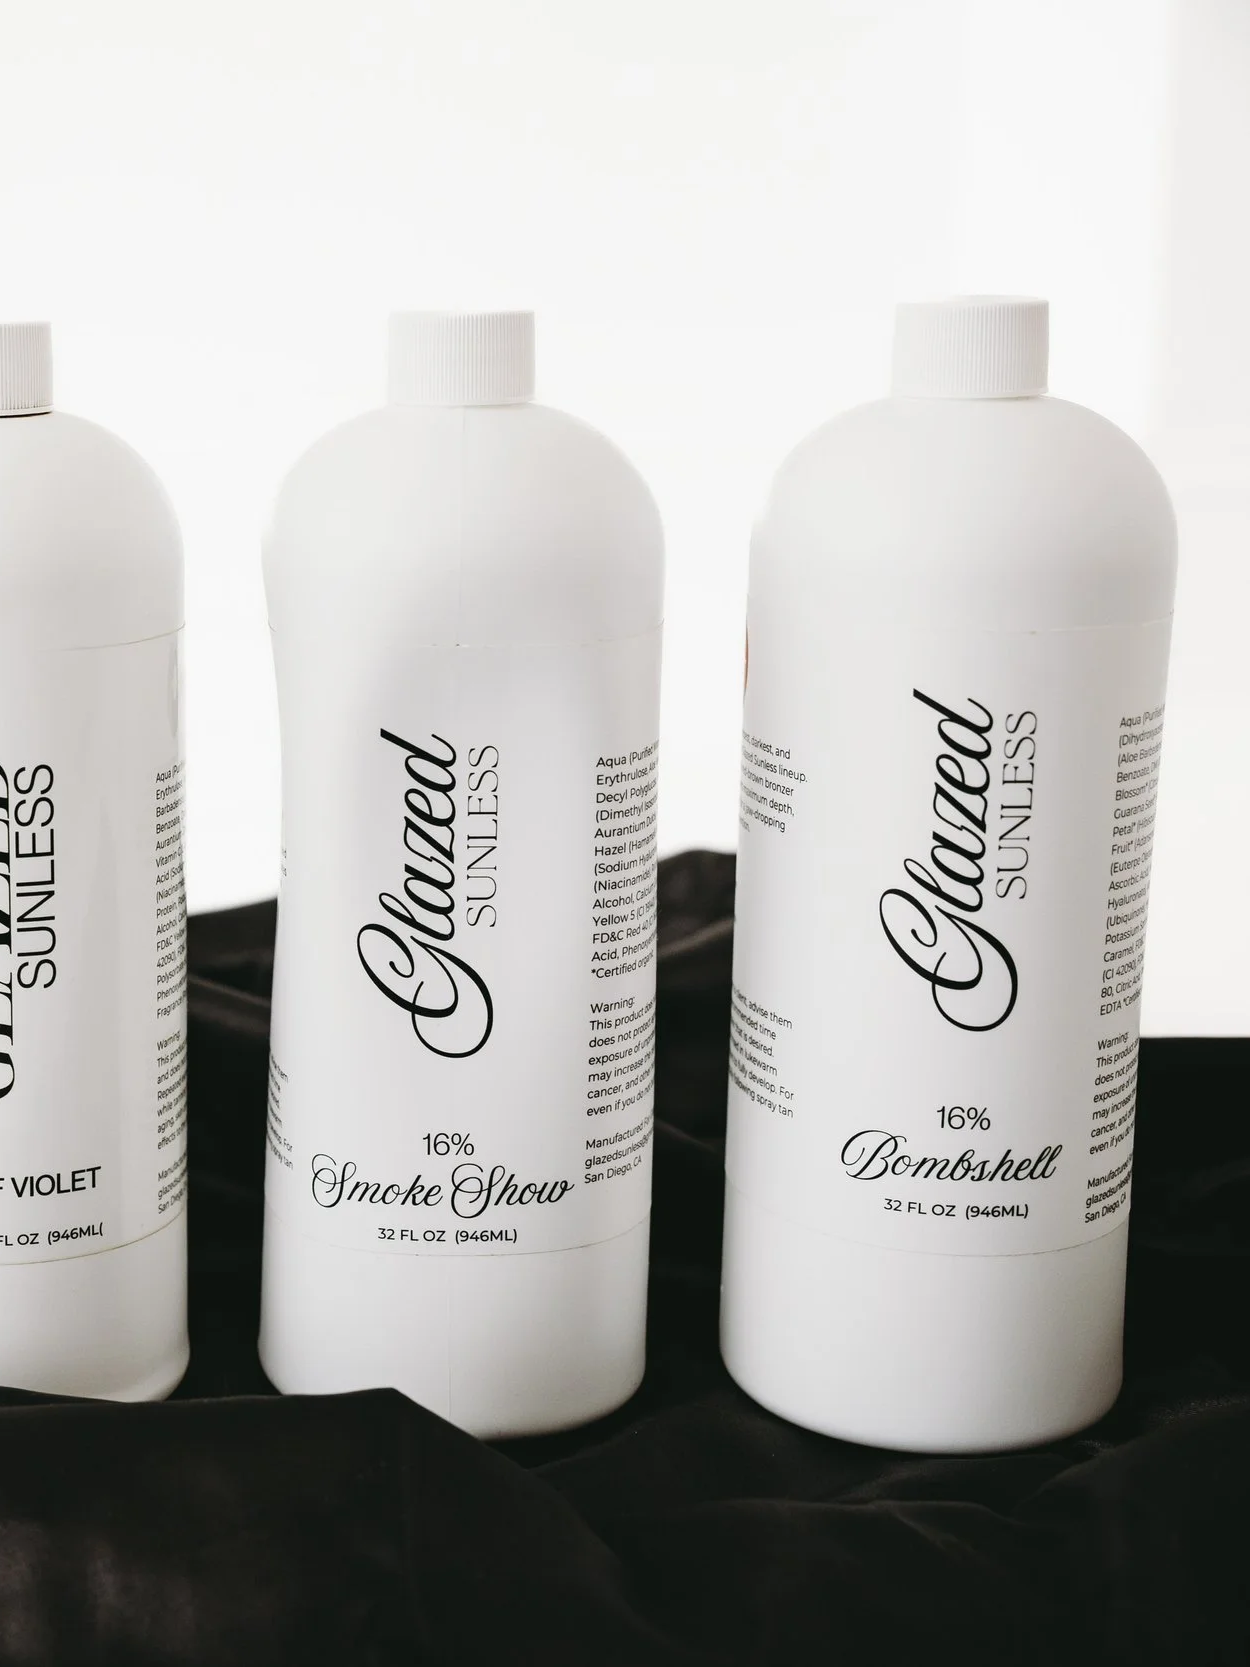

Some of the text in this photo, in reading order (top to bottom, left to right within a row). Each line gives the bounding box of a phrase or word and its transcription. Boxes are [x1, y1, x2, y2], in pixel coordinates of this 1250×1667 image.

[1119, 716, 1141, 729] Aqua
[596, 756, 627, 768] Aqua
[775, 747, 791, 760] and
[778, 763, 808, 783] lineup.
[764, 776, 794, 797] bronzer
[596, 789, 628, 803] Decyl
[995, 710, 1038, 900] SUNLESS
[595, 802, 644, 823] (Dimethyl
[466, 745, 500, 928] SUNLESS
[594, 820, 646, 839] Aurantium
[594, 842, 627, 856] Hazel
[594, 858, 638, 876] (Sodium
[879, 688, 1018, 1032] Glazed
[13, 763, 57, 990] SUNLESS
[356, 727, 494, 1059] Glazed
[592, 892, 634, 910] Alcohol,
[592, 913, 629, 927] Yellow
[592, 923, 641, 944] FD&C Red
[591, 948, 620, 962] Acid,
[1100, 1000, 1121, 1016] EDTA
[590, 1008, 644, 1030] This product
[769, 1011, 793, 1029] them
[589, 1030, 632, 1048] does not
[759, 1023, 777, 1040] time
[588, 1047, 633, 1066] exposure
[1096, 1055, 1113, 1068] This
[588, 1057, 644, 1083] may increase
[1094, 1073, 1114, 1086] does
[587, 1084, 624, 1099] cancer,
[1093, 1083, 1126, 1103] exposure
[586, 1103, 612, 1117] even
[756, 1093, 793, 1118] spray tan
[1092, 1107, 1111, 1120] may
[936, 1105, 991, 1131] 16%
[422, 1132, 475, 1156] 16%
[1089, 1141, 1109, 1155] even
[840, 1129, 1063, 1182] Bombshell
[10, 1166, 102, 1198] VIOLET
[311, 1153, 576, 1219] Smoke Show
[584, 1172, 604, 1184] San
[883, 1198, 1029, 1220] 32 FL OZ (946ML)
[1084, 1211, 1100, 1223] San
[17, 1233, 40, 1246] OZ
[377, 1227, 518, 1244] 32 FL OZ (946ML)
